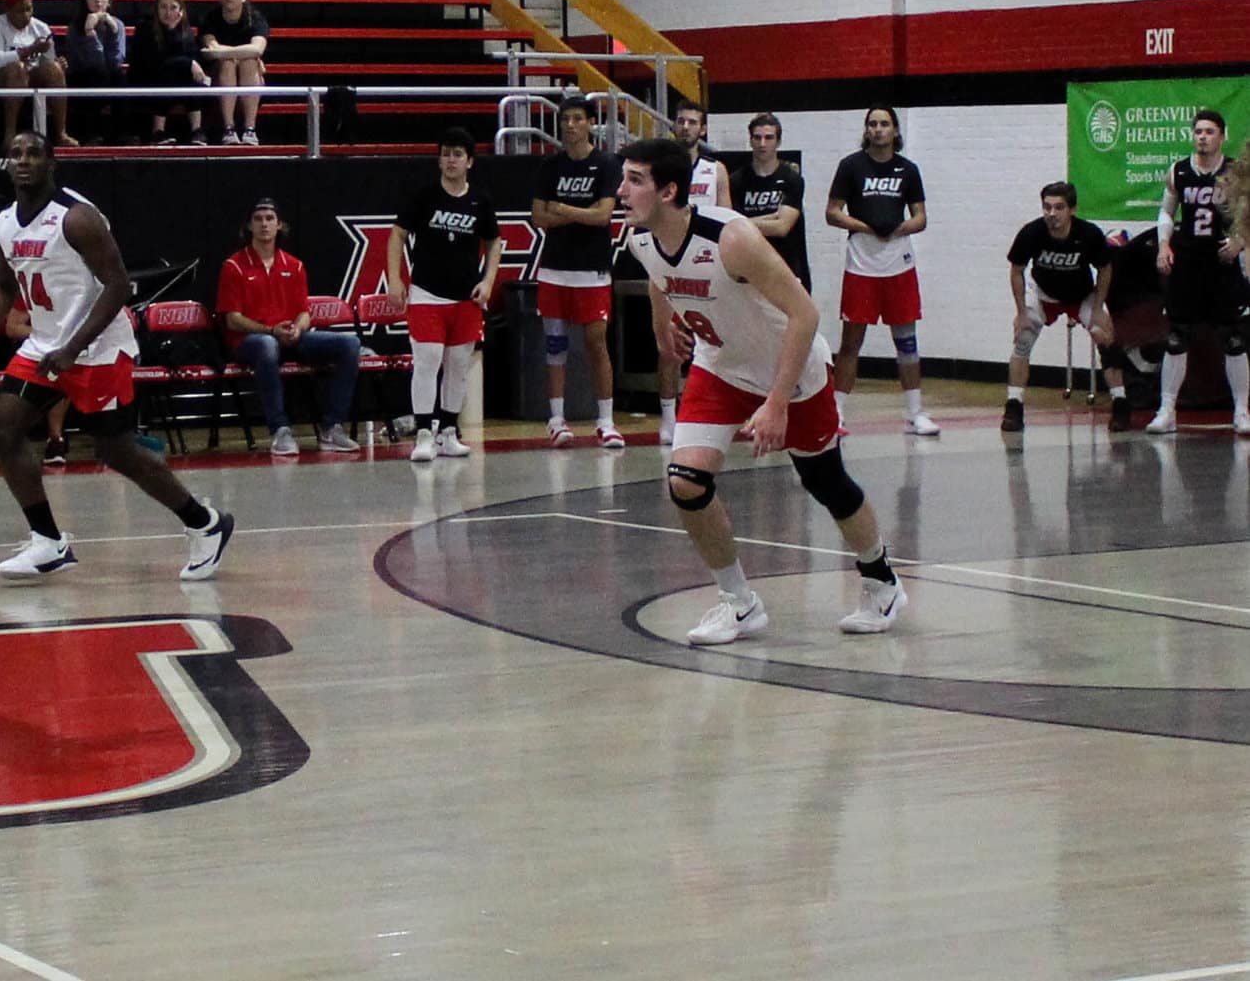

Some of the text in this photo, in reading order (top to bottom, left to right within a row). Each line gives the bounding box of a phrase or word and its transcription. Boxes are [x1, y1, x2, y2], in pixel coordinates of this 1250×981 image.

[1145, 27, 1175, 56] EXIT
[1125, 125, 1176, 143] HEALTH
[557, 176, 596, 192] NGU
[862, 176, 903, 191] NGU
[1125, 168, 1152, 185] Sports
[744, 189, 784, 206] NGU
[430, 209, 478, 228] NGU
[1193, 207, 1214, 237] 2
[10, 240, 49, 259] NGU
[1037, 249, 1081, 266] NGU
[663, 275, 712, 298] NGU
[156, 306, 201, 325] NGU
